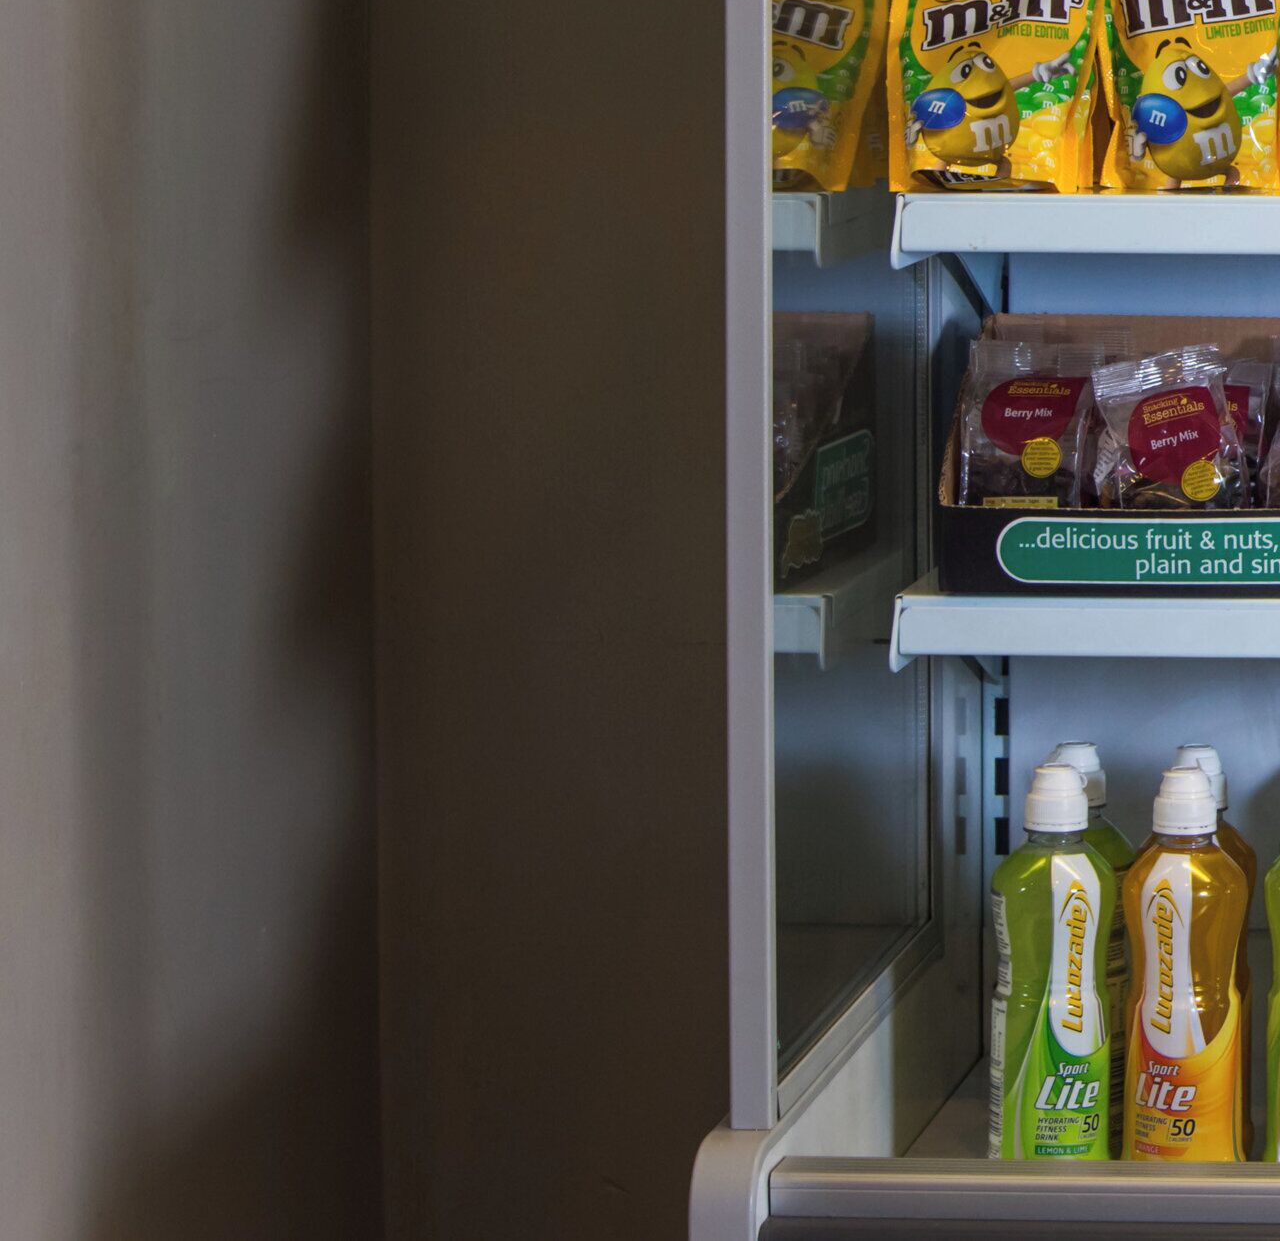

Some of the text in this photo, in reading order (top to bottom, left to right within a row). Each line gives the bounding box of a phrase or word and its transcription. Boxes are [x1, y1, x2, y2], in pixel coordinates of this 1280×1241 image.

[1034, 26, 1070, 40] EDITION
[1205, 23, 1242, 40] LIMITED
[1007, 384, 1071, 397] Essentials
[1004, 407, 1054, 419] Berry Mix
[1150, 429, 1199, 450] Berry Mix
[1020, 527, 1279, 554] ...delicious fruit & nuts,
[1135, 554, 1191, 579] plain
[1199, 554, 1243, 576] and
[1061, 905, 1089, 1035] Lucozade
[1150, 903, 1178, 1035] Lucozade
[1034, 1074, 1100, 1111] Lite
